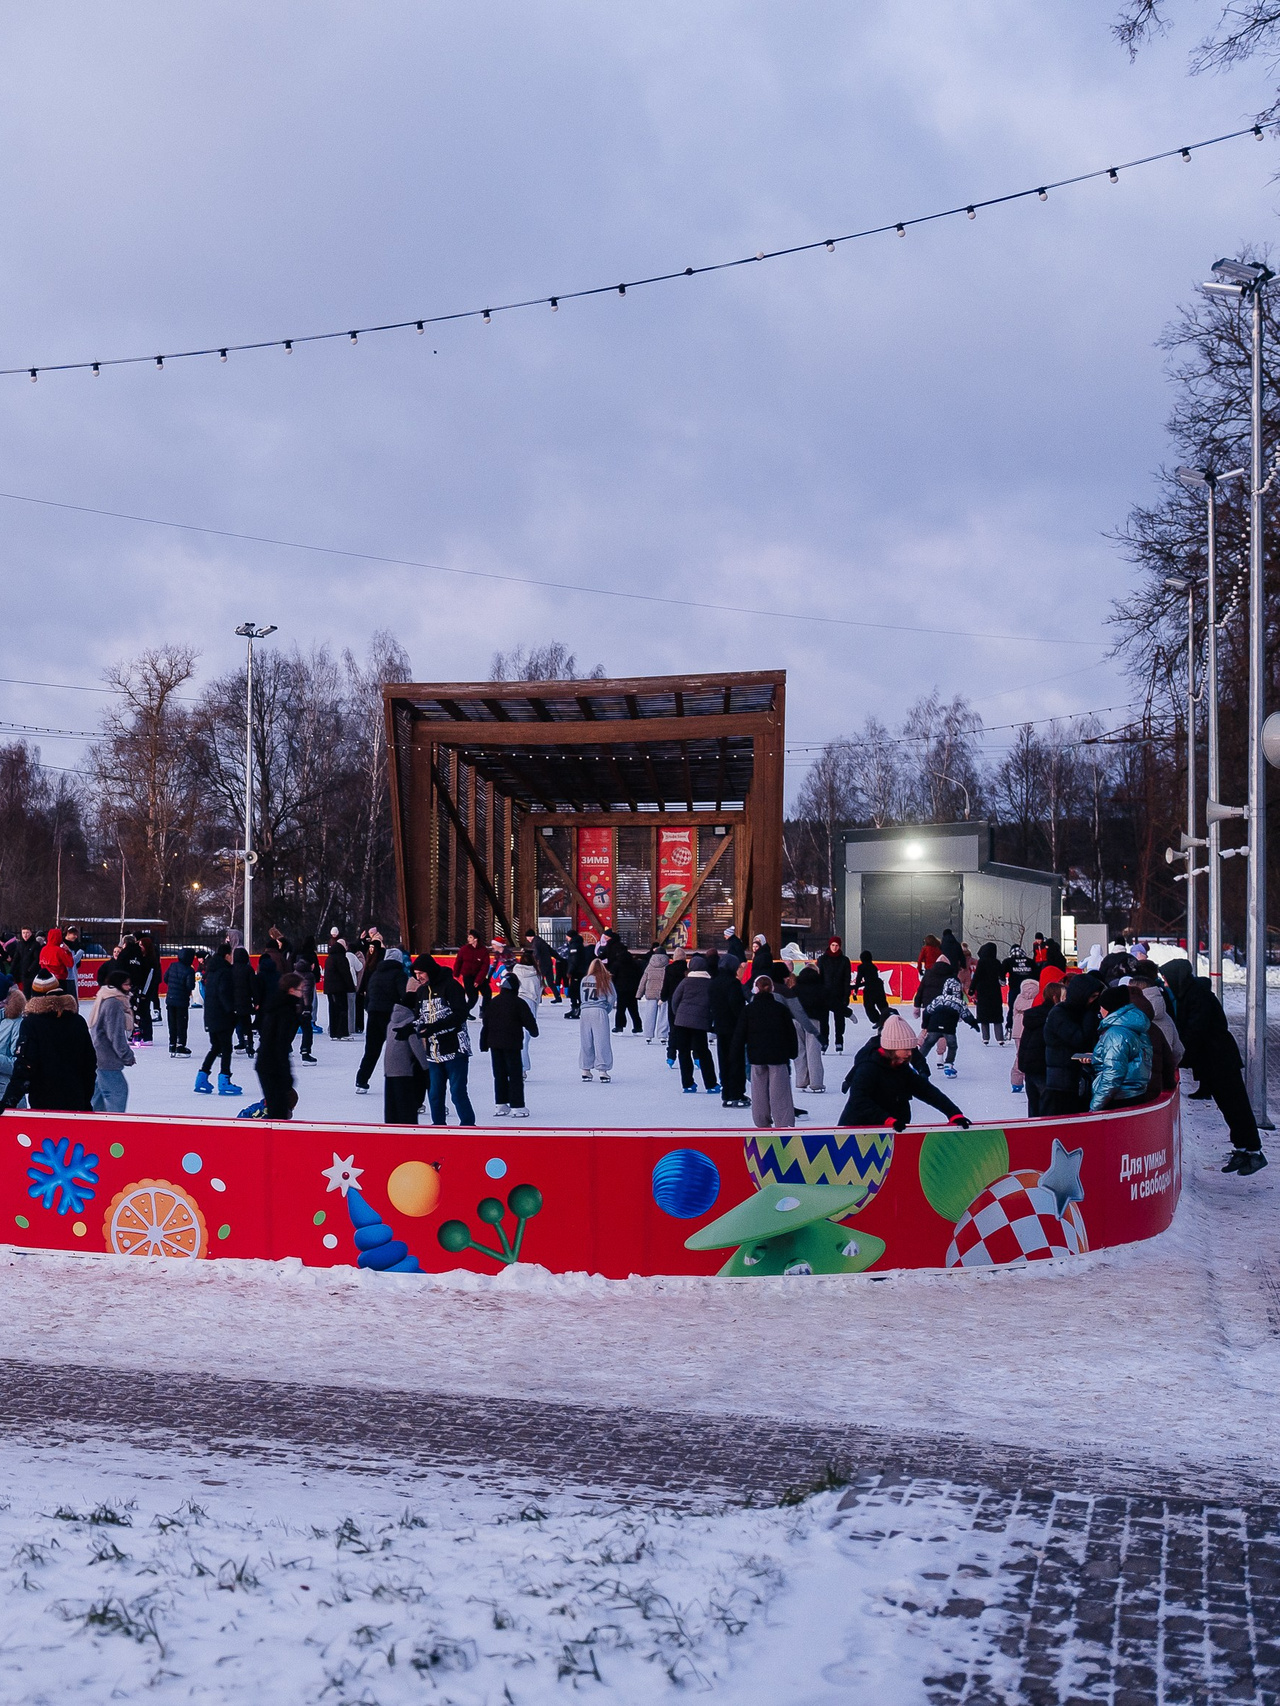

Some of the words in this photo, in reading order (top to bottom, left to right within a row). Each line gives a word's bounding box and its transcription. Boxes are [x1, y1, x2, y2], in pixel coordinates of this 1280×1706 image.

[583, 988, 598, 1001] 14
[1119, 1154, 1142, 1183] Для
[1143, 1148, 1167, 1178] умных
[1130, 1184, 1138, 1201] и
